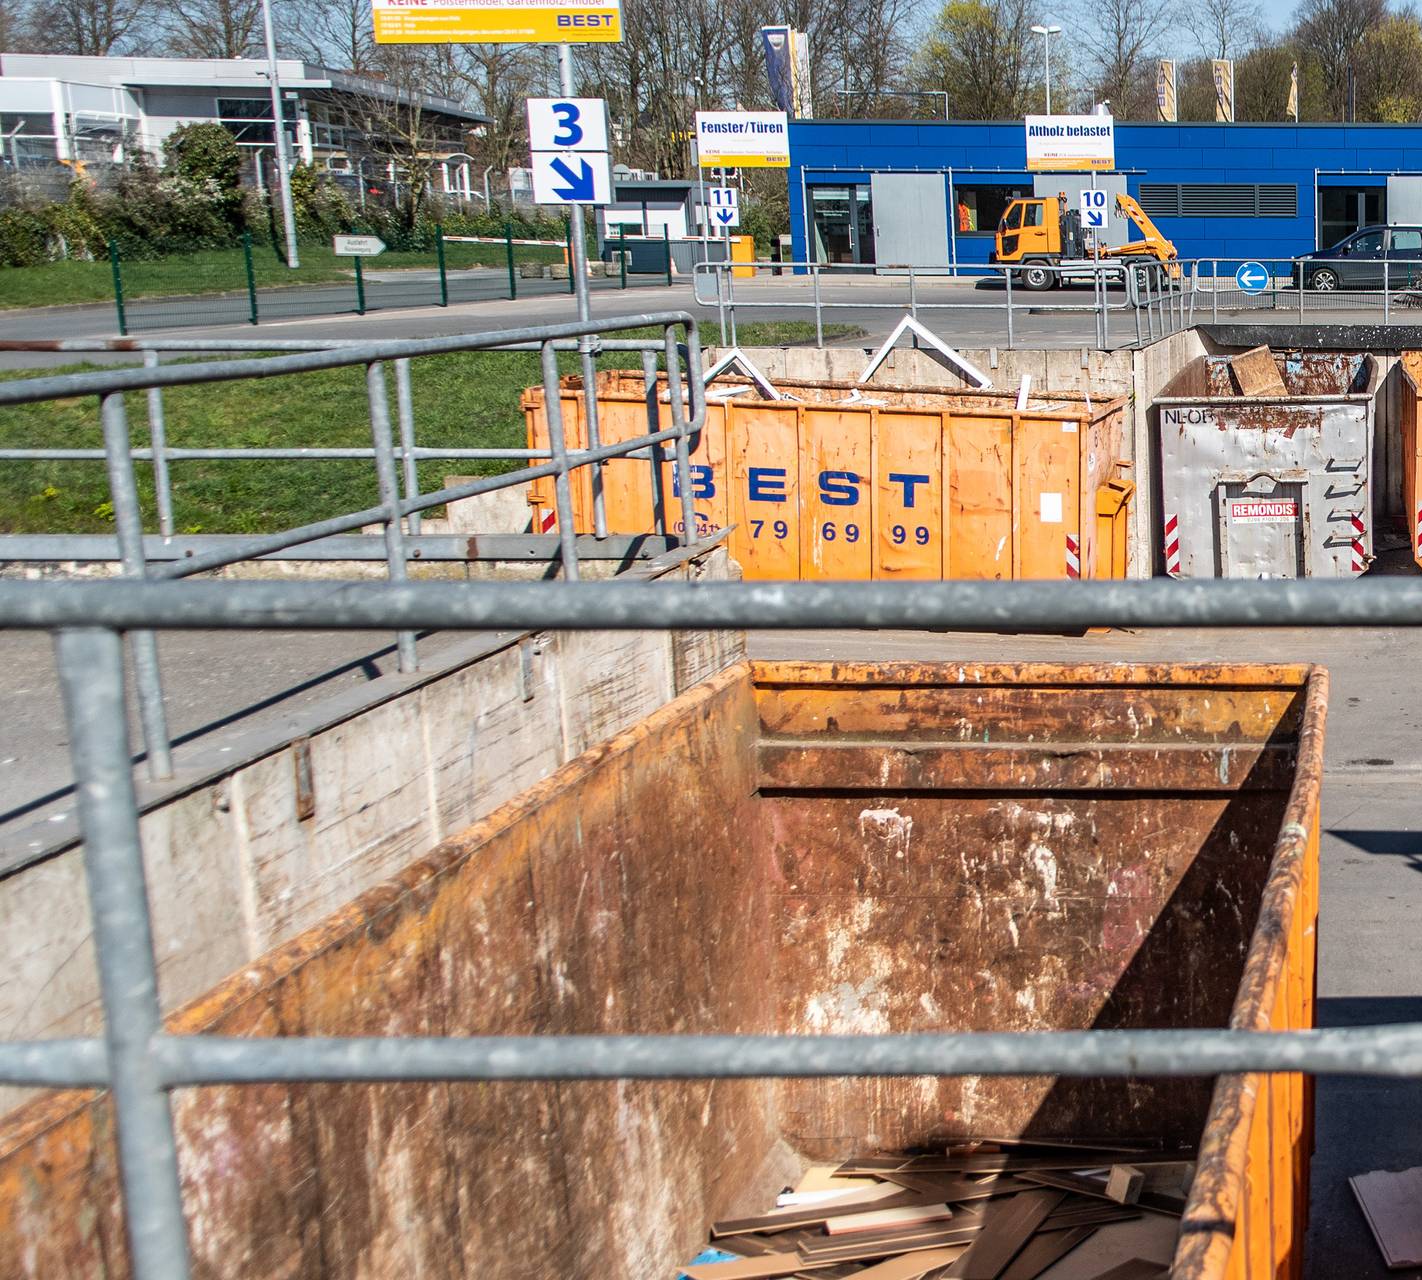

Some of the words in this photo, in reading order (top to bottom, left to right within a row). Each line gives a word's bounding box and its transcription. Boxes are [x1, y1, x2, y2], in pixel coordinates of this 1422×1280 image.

[557, 15, 614, 27] BEST
[552, 103, 583, 146] 3
[701, 121, 783, 133] Fenster/Türen
[1029, 125, 1064, 136] Altholz
[1067, 125, 1110, 137] belastet
[713, 190, 732, 205] 11
[1083, 191, 1105, 207] 10
[673, 463, 930, 508] BEST
